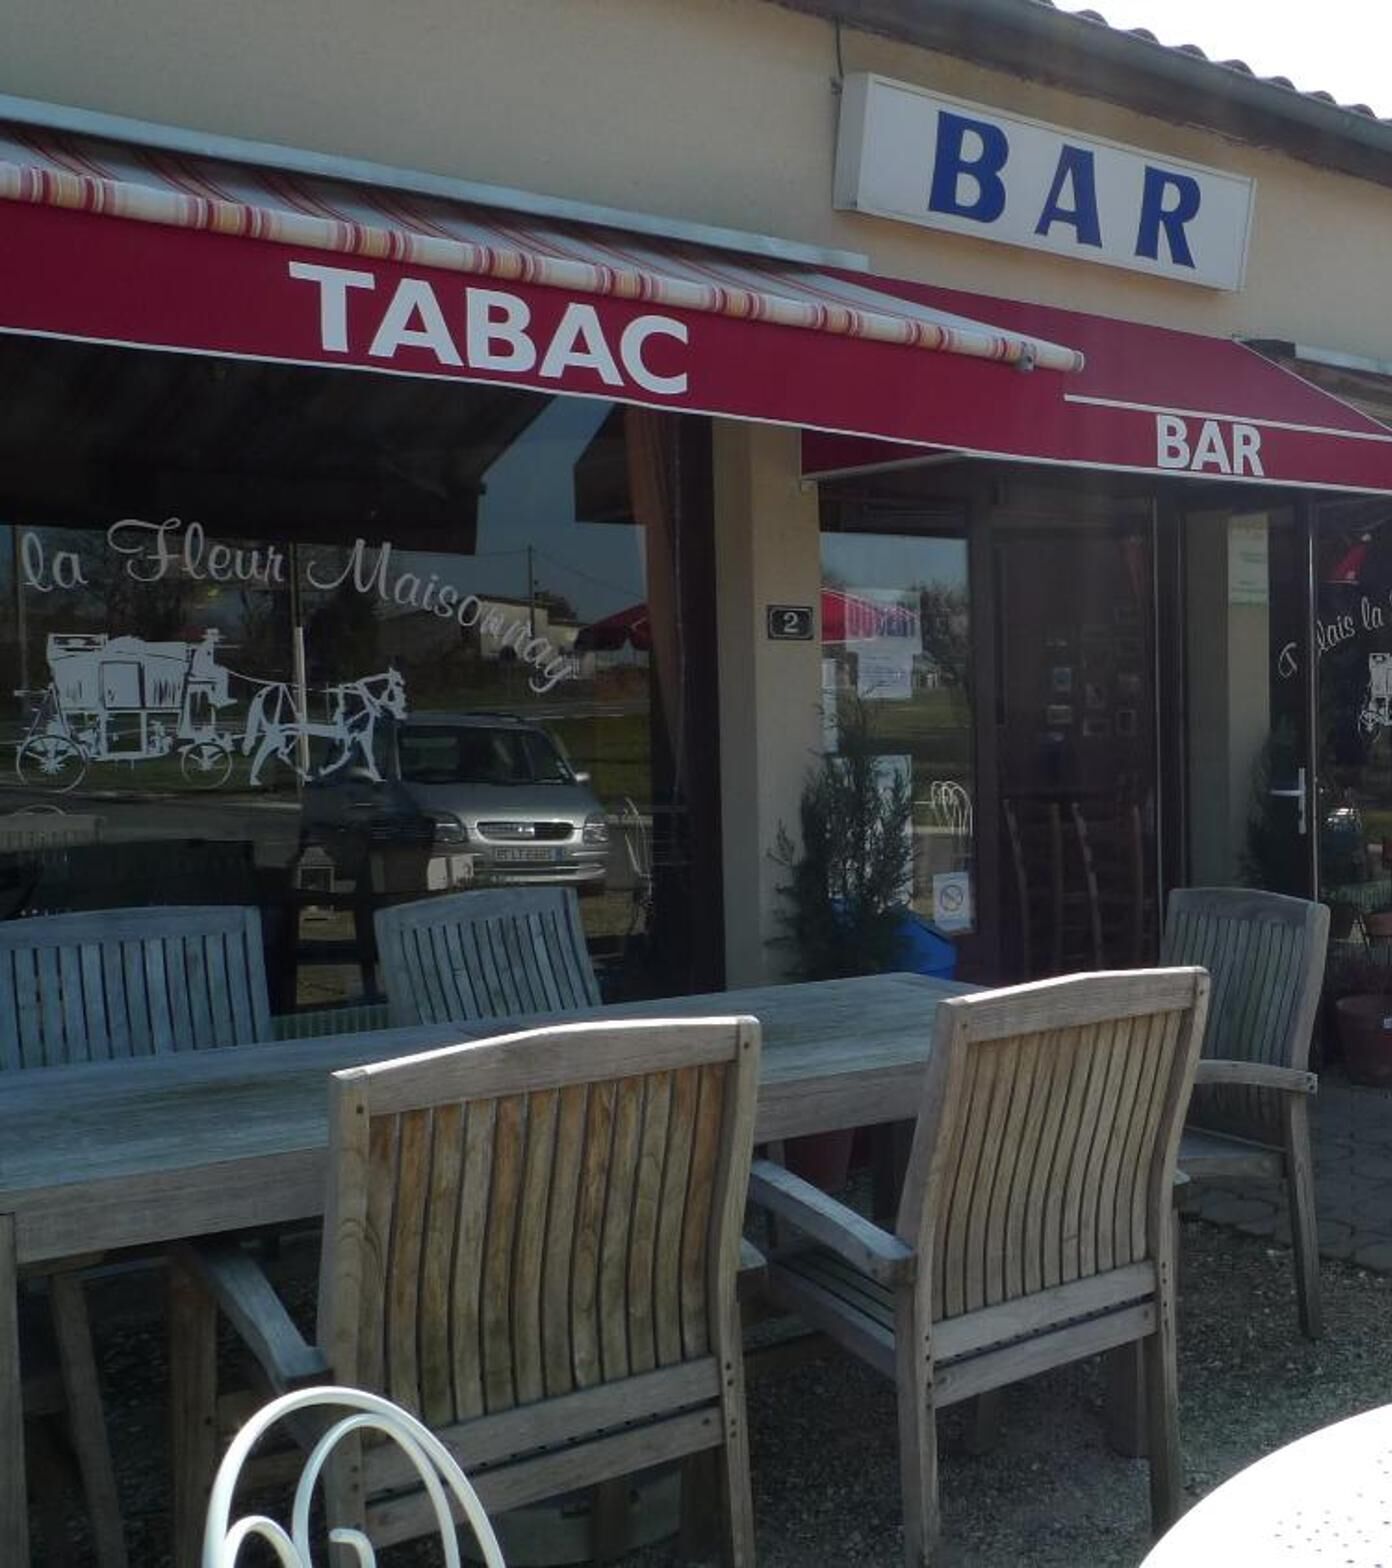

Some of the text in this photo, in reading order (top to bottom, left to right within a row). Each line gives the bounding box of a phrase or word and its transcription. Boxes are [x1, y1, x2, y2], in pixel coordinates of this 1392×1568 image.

[928, 110, 1202, 269] BAR
[288, 261, 689, 395] TABAC
[1156, 413, 1265, 477] BAR
[21, 517, 573, 693] la Fleur Maisonnay
[782, 611, 799, 634] 2
[1278, 615, 1356, 679] lais
[1361, 596, 1385, 631] la
